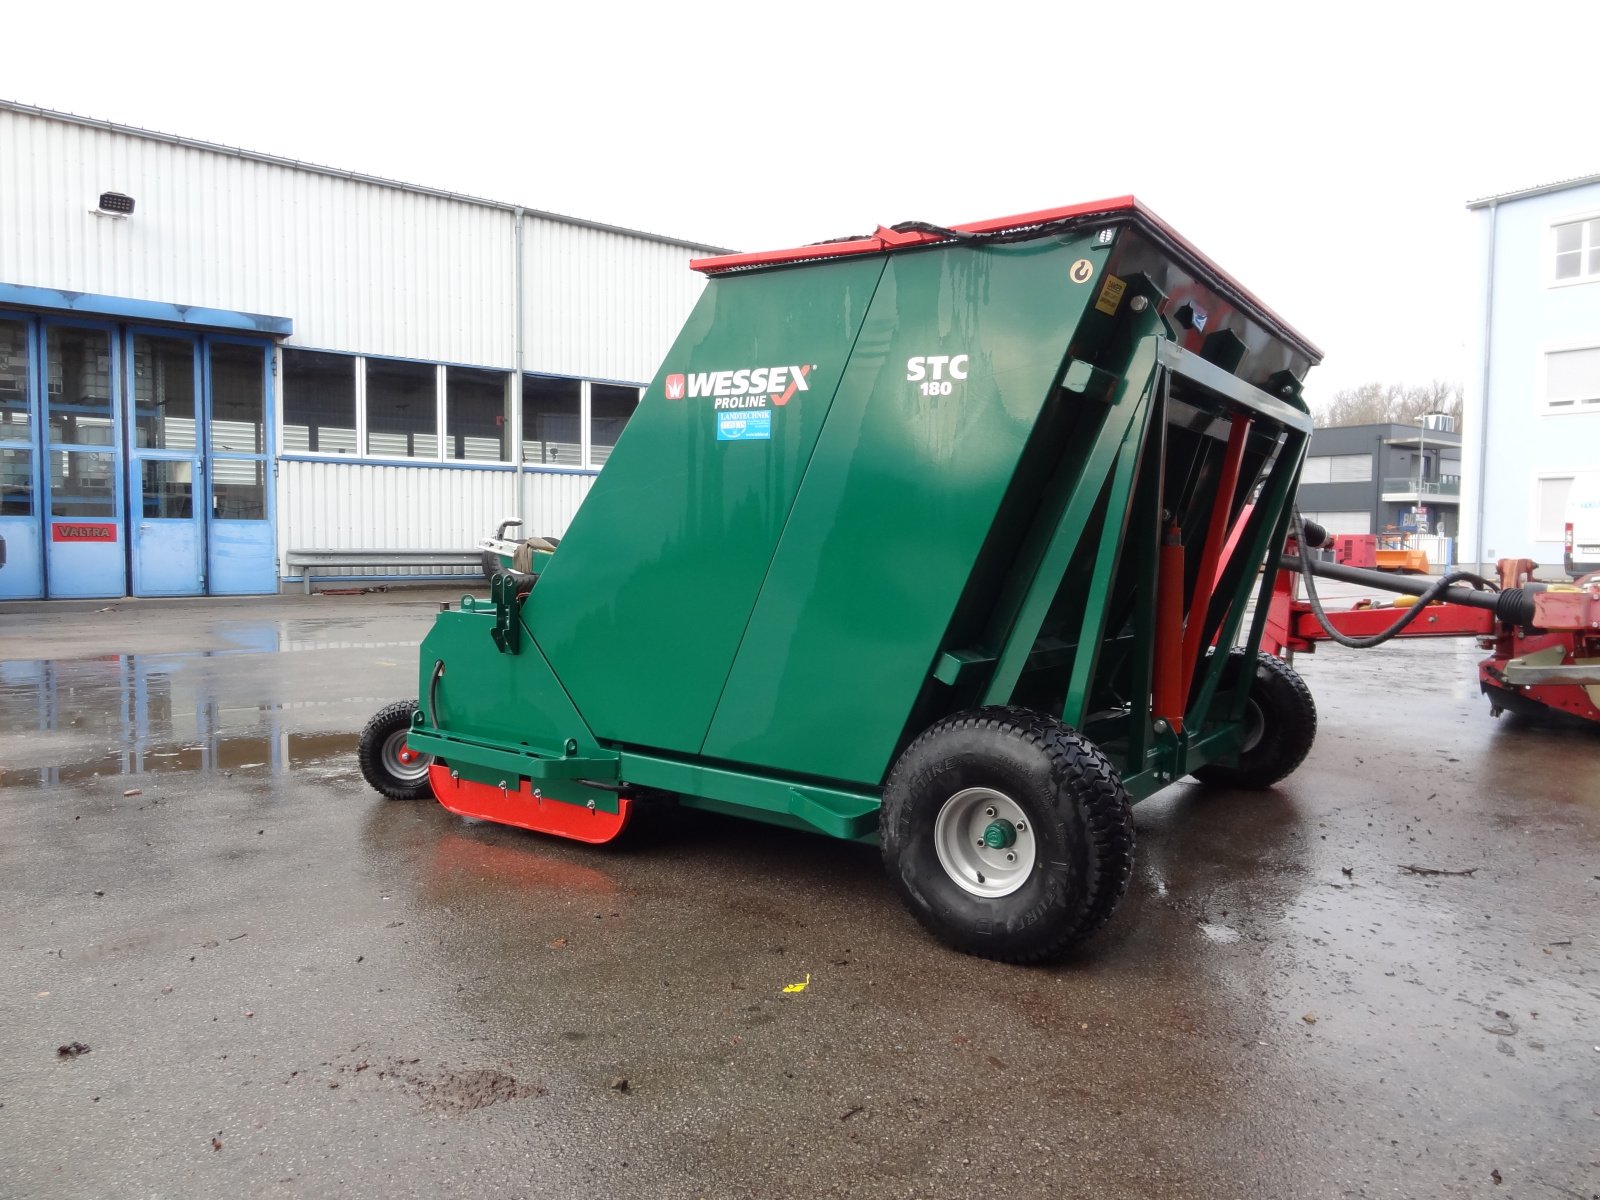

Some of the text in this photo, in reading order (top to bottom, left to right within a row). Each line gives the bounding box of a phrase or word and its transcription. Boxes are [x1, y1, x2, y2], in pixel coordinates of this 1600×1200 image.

[906, 354, 969, 381] STC
[687, 364, 810, 404] WESSEX
[920, 381, 952, 396] 180
[714, 395, 767, 410] PROLINE
[720, 411, 770, 420] LANDTECHNIK
[58, 525, 110, 538] VALTRA
